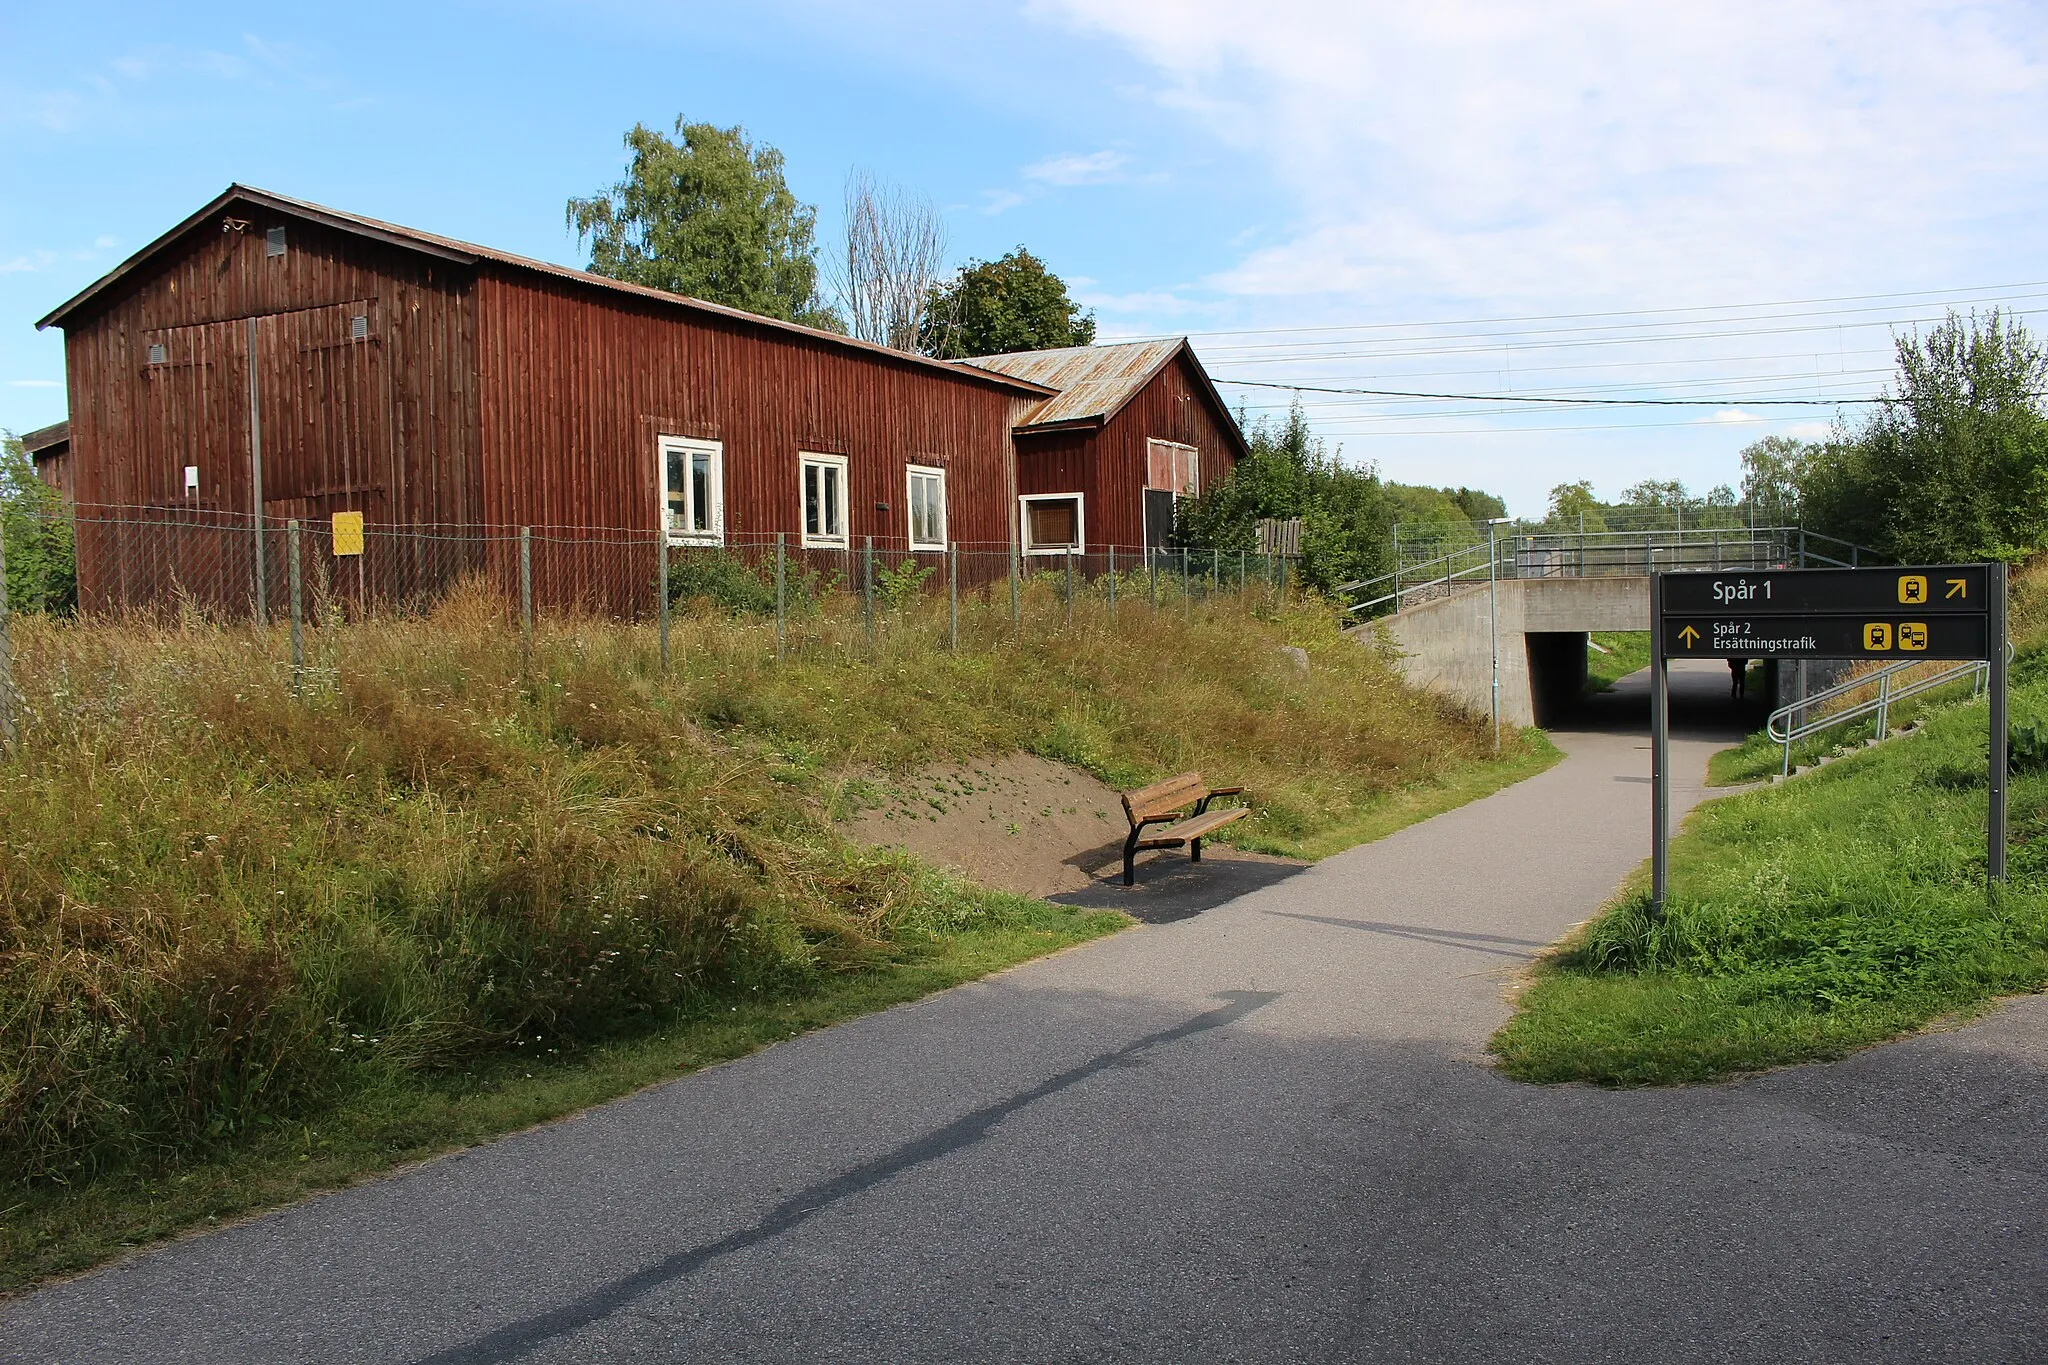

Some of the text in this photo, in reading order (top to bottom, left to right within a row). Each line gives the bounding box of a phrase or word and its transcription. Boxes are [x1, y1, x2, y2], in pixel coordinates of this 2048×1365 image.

[1713, 579, 1771, 605] Spår 1
[1713, 621, 1751, 637] Spår 2
[1713, 636, 1816, 652] Ersättningstrafik
